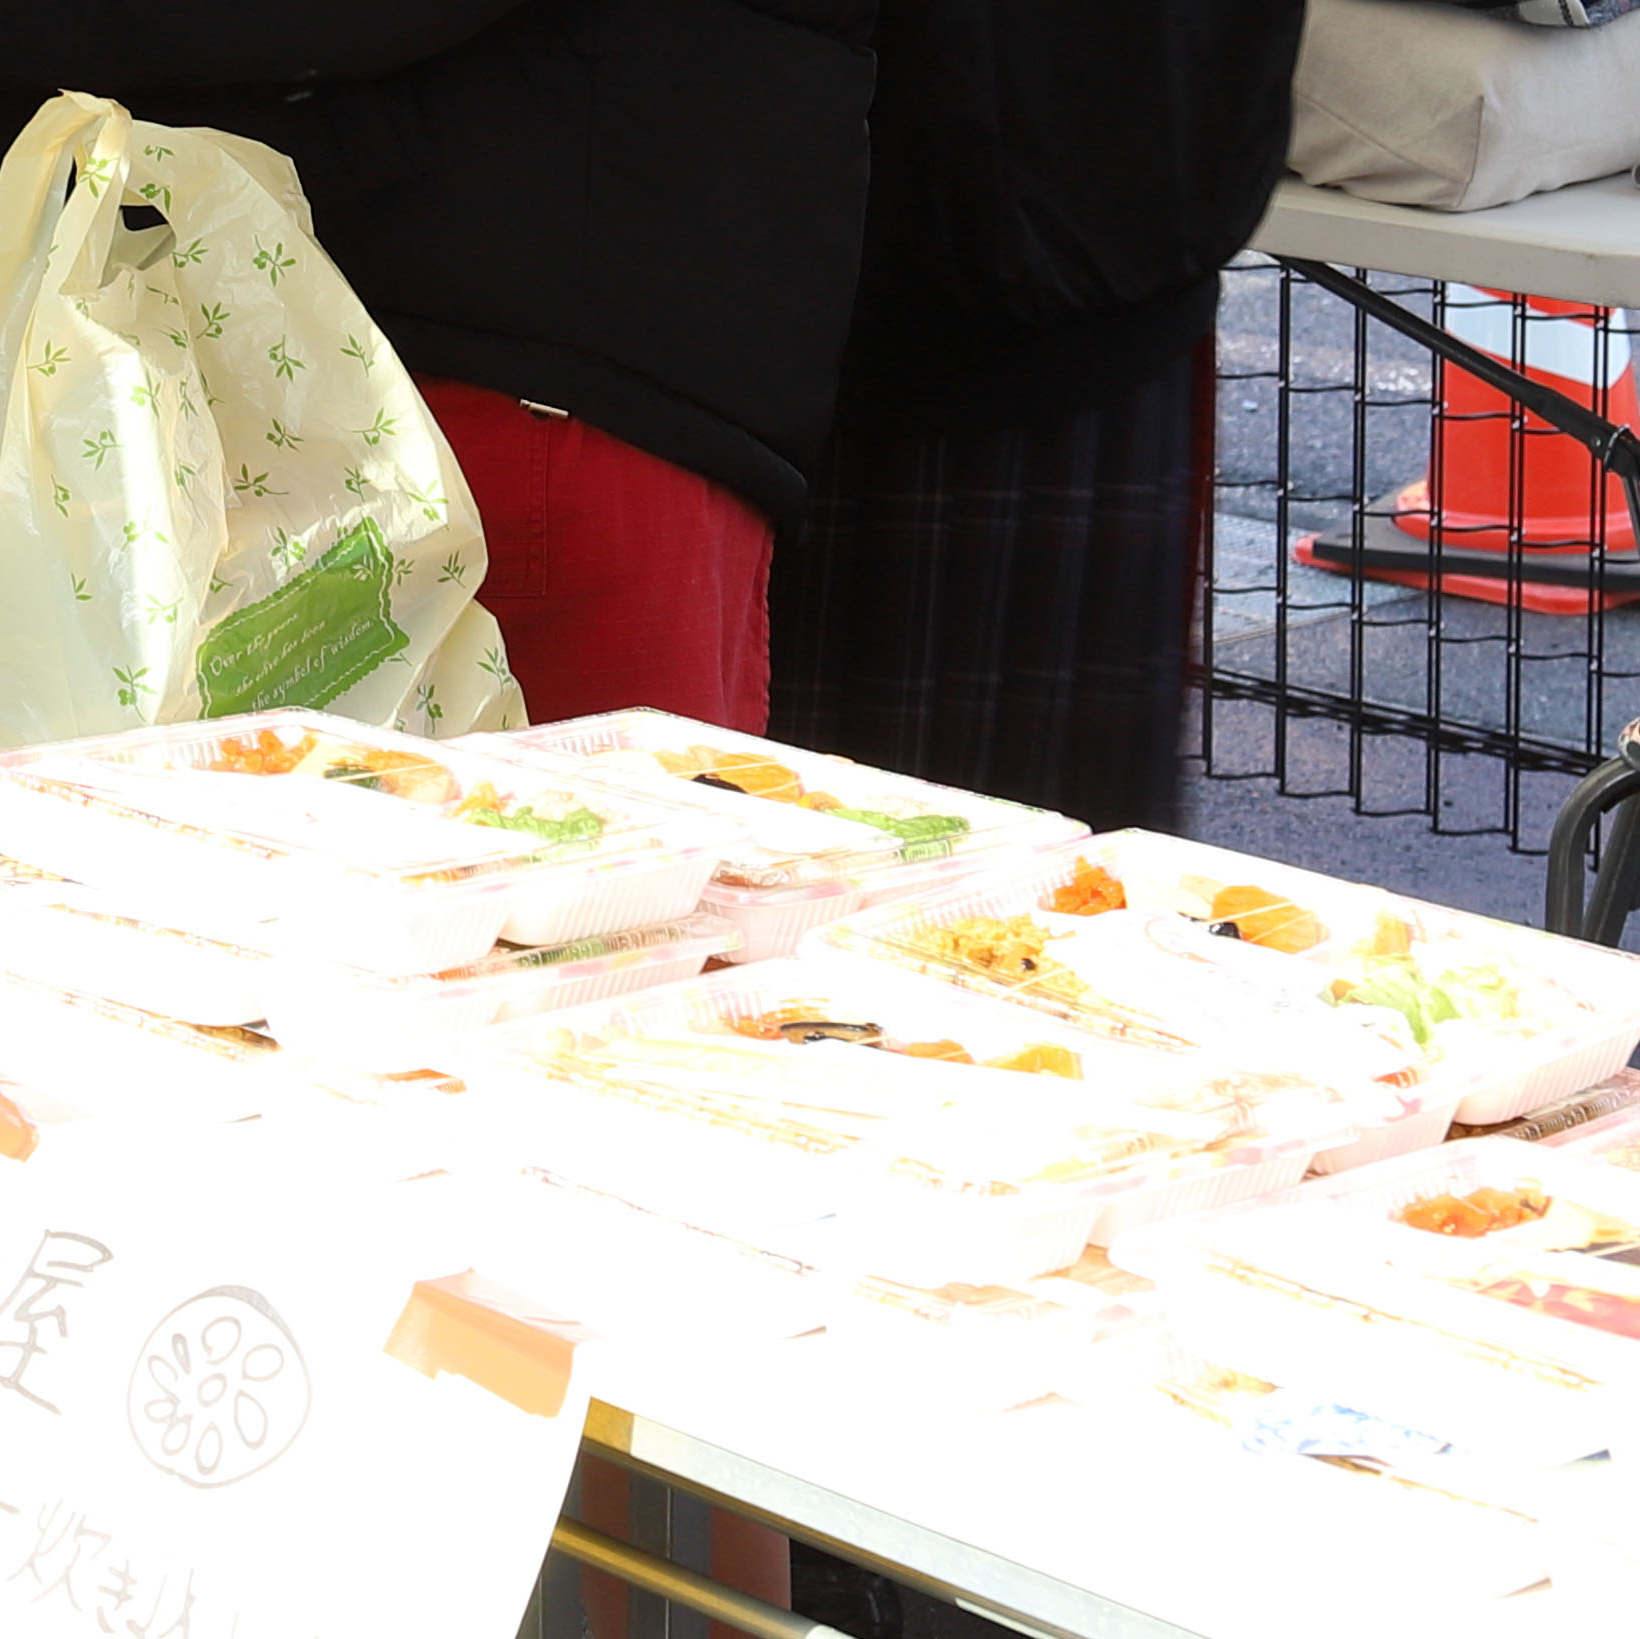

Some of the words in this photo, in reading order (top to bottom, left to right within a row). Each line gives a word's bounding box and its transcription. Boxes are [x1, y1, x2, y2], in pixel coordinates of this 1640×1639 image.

[209, 650, 243, 677] Over
[251, 689, 270, 712] the
[272, 655, 311, 704] symbol
[313, 644, 328, 673] of
[329, 619, 374, 656] wisdom.
